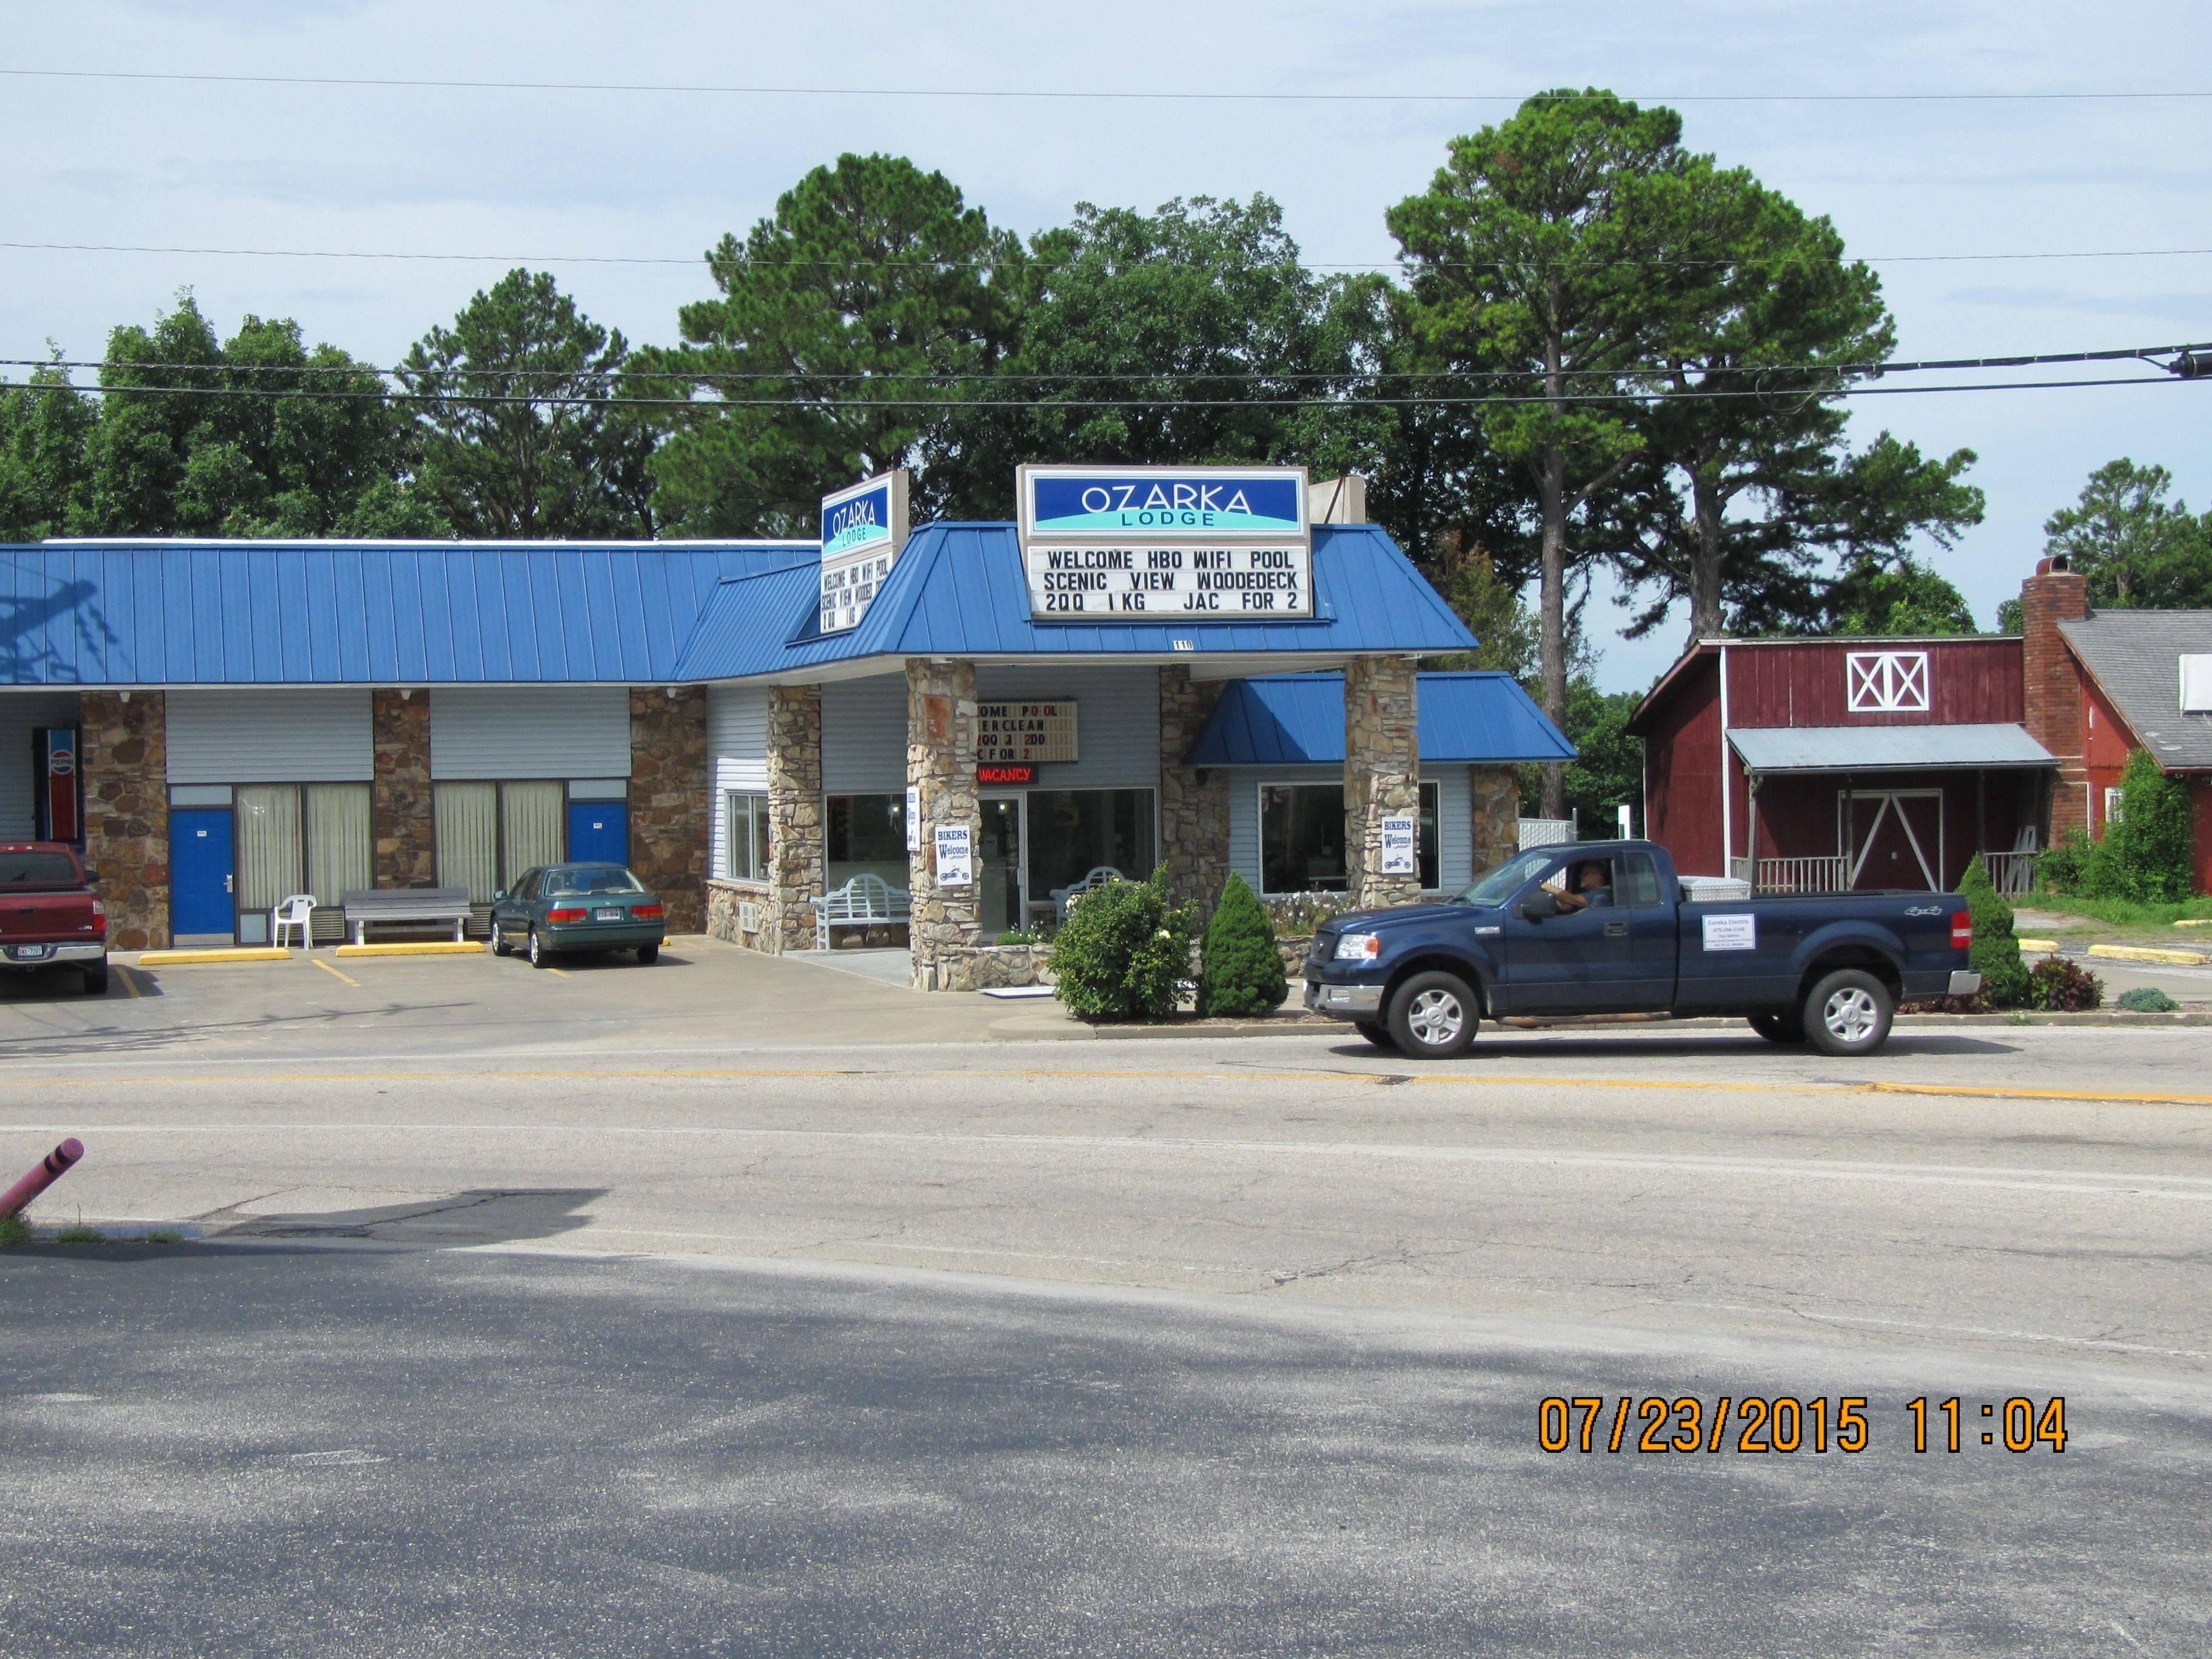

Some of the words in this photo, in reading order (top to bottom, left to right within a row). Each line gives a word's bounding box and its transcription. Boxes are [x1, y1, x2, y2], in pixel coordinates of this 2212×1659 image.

[1081, 483, 1252, 515] OZARKA
[833, 500, 876, 537] OZARKA
[1121, 511, 1215, 527] LODGE
[842, 527, 866, 547] LODGE
[1047, 550, 1133, 569] WELCOME
[1147, 551, 1182, 569] HBO
[1193, 551, 1232, 569] WIFI
[1250, 551, 1295, 569] POOL
[823, 570, 845, 592] WELCOME
[850, 566, 859, 585] HBO
[862, 561, 873, 582] WIFI
[876, 557, 888, 577] POOL
[1044, 573, 1107, 591] SCENIC
[1130, 572, 1175, 590] VIEW
[822, 592, 837, 612] SCENIC
[839, 588, 852, 607] VIEW
[1184, 592, 1219, 610] JAC
[1242, 592, 1274, 610] FOR
[1288, 592, 1298, 609] 2
[1176, 640, 1192, 649] 110
[977, 706, 1007, 717] OME
[1024, 748, 1030, 759] 2
[979, 768, 1030, 781] VACANCY
[1384, 820, 1411, 830] BIKERS
[938, 830, 968, 840] BIKERS
[1384, 834, 1411, 848] Welcome
[939, 843, 968, 859] Welcome
